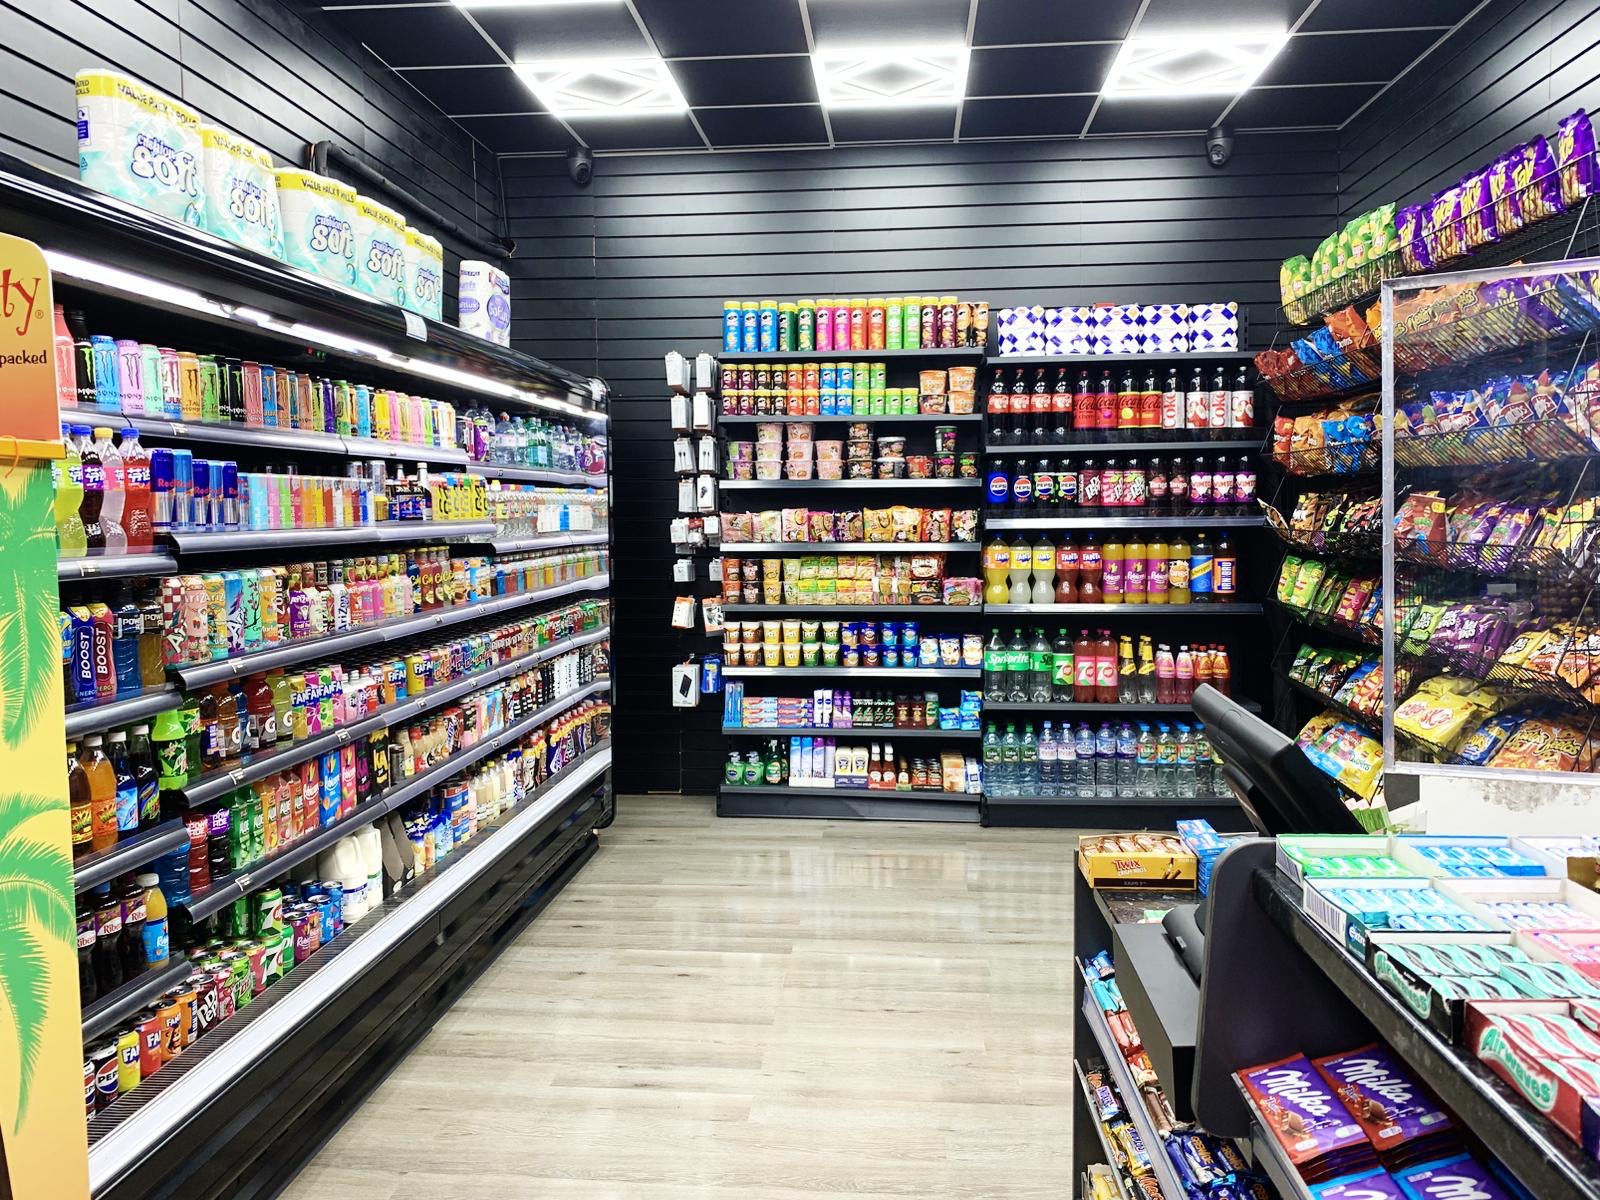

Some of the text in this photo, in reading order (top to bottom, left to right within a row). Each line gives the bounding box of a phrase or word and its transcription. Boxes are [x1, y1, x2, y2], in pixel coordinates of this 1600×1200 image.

[131, 145, 197, 197] soft
[230, 189, 277, 230] soft
[310, 222, 354, 259] soft
[367, 247, 405, 282] soft
[0, 350, 47, 367] packed
[80, 632, 92, 679] BOOST
[96, 628, 108, 675] BOOST
[1114, 859, 1140, 871] Twix
[1336, 1059, 1412, 1105] Milka
[1480, 1027, 1556, 1111] Airwaves
[1260, 1069, 1331, 1117] Milka
